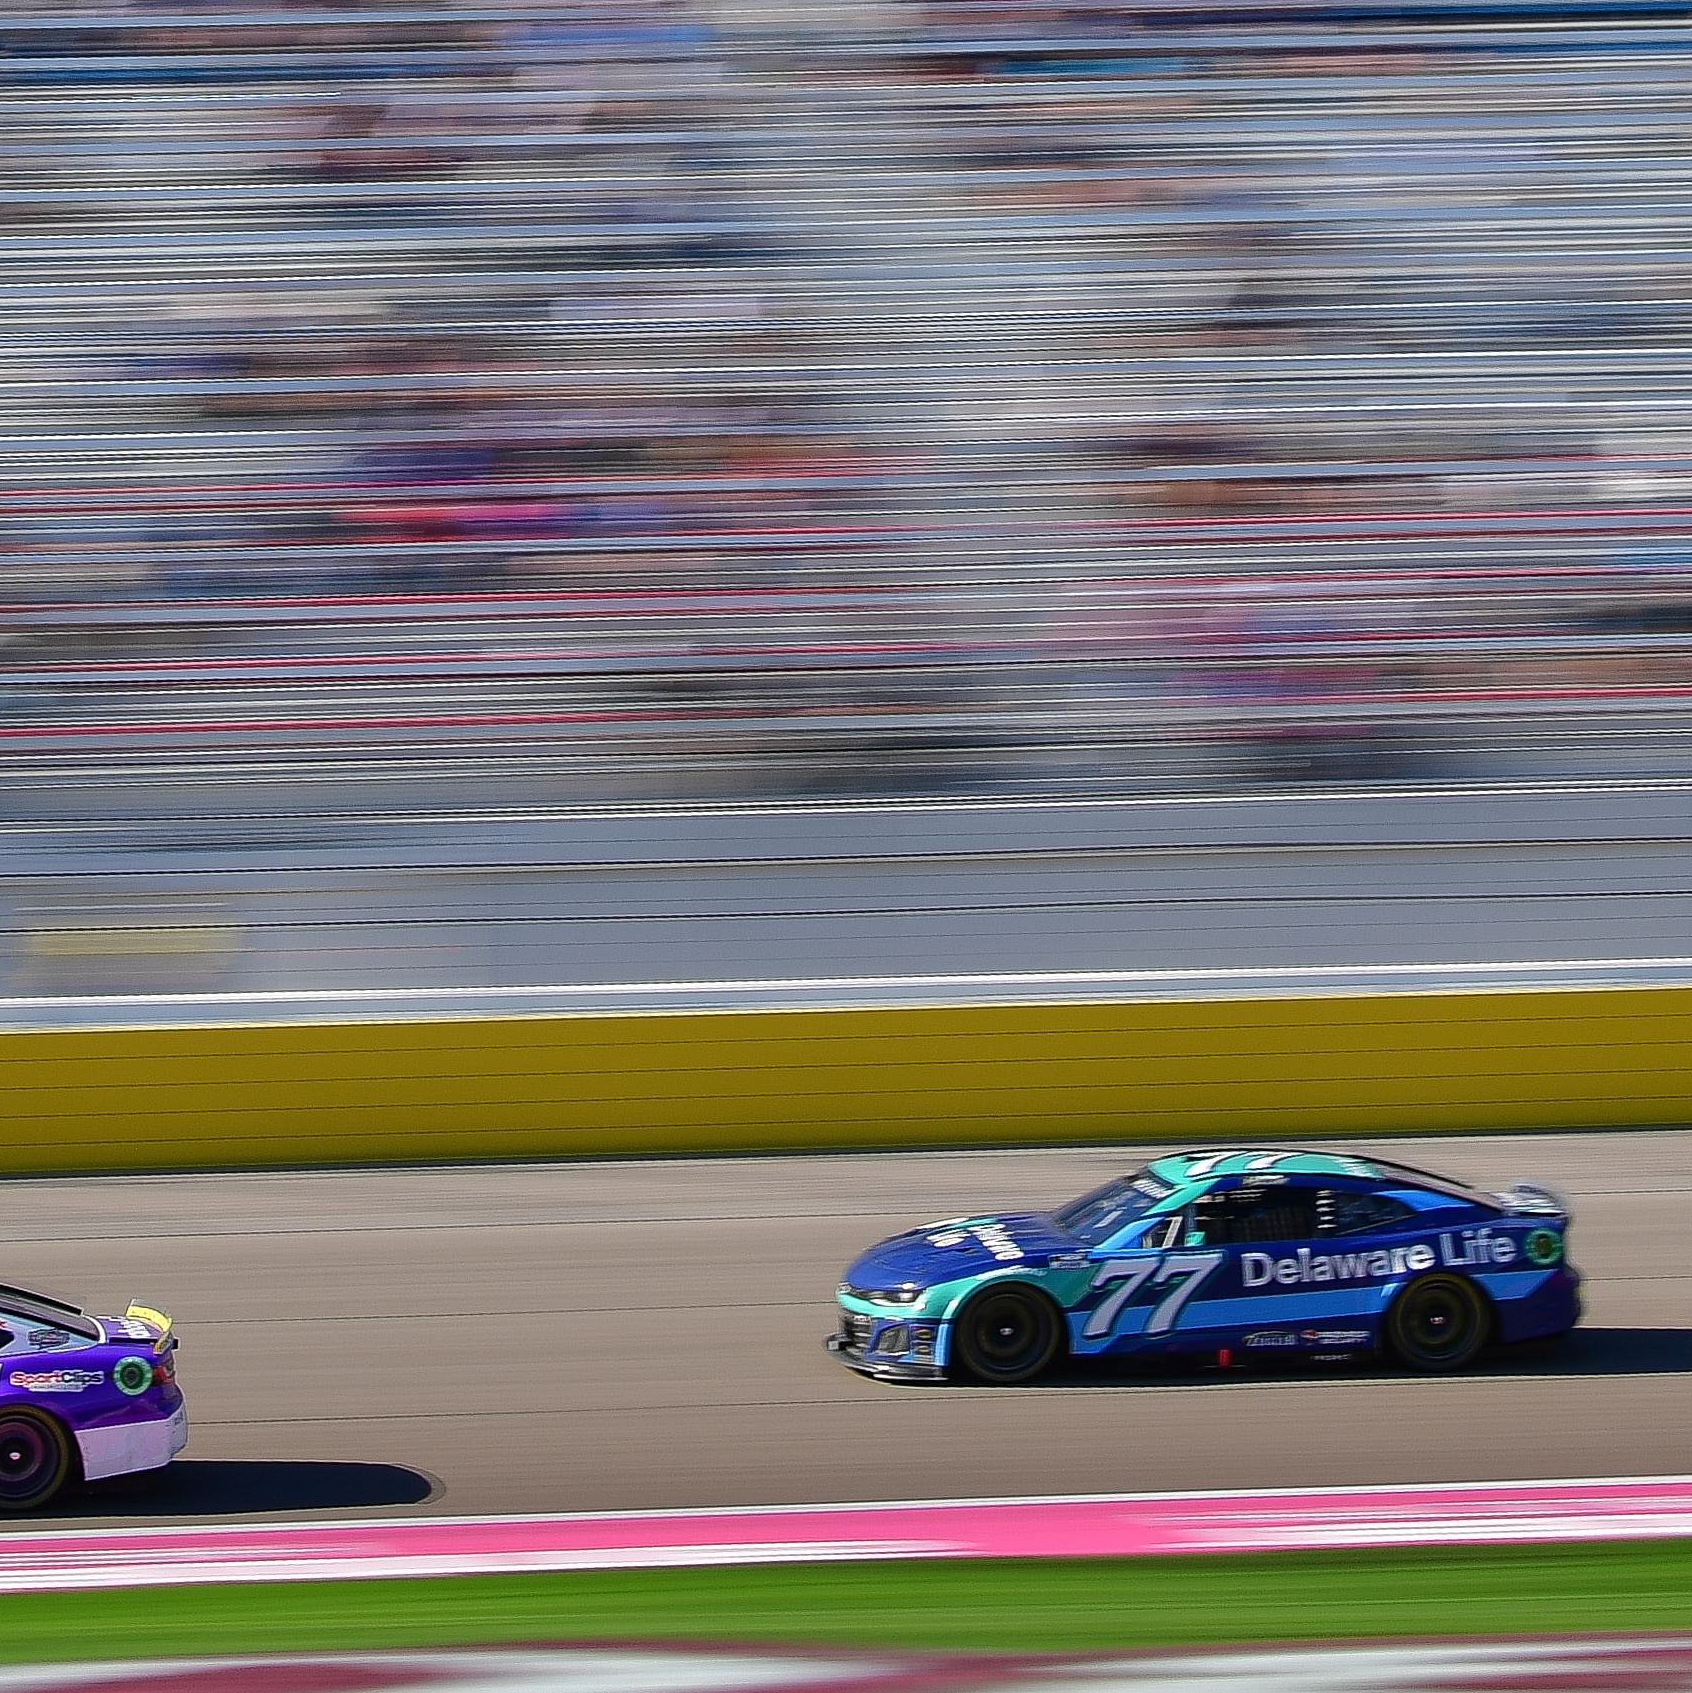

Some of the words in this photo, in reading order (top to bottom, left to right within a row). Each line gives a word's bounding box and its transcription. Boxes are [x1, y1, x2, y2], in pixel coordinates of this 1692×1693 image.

[1240, 1247, 1437, 1288] Delaware
[1438, 1228, 1518, 1267] Life
[1083, 1252, 1227, 1339] 77
